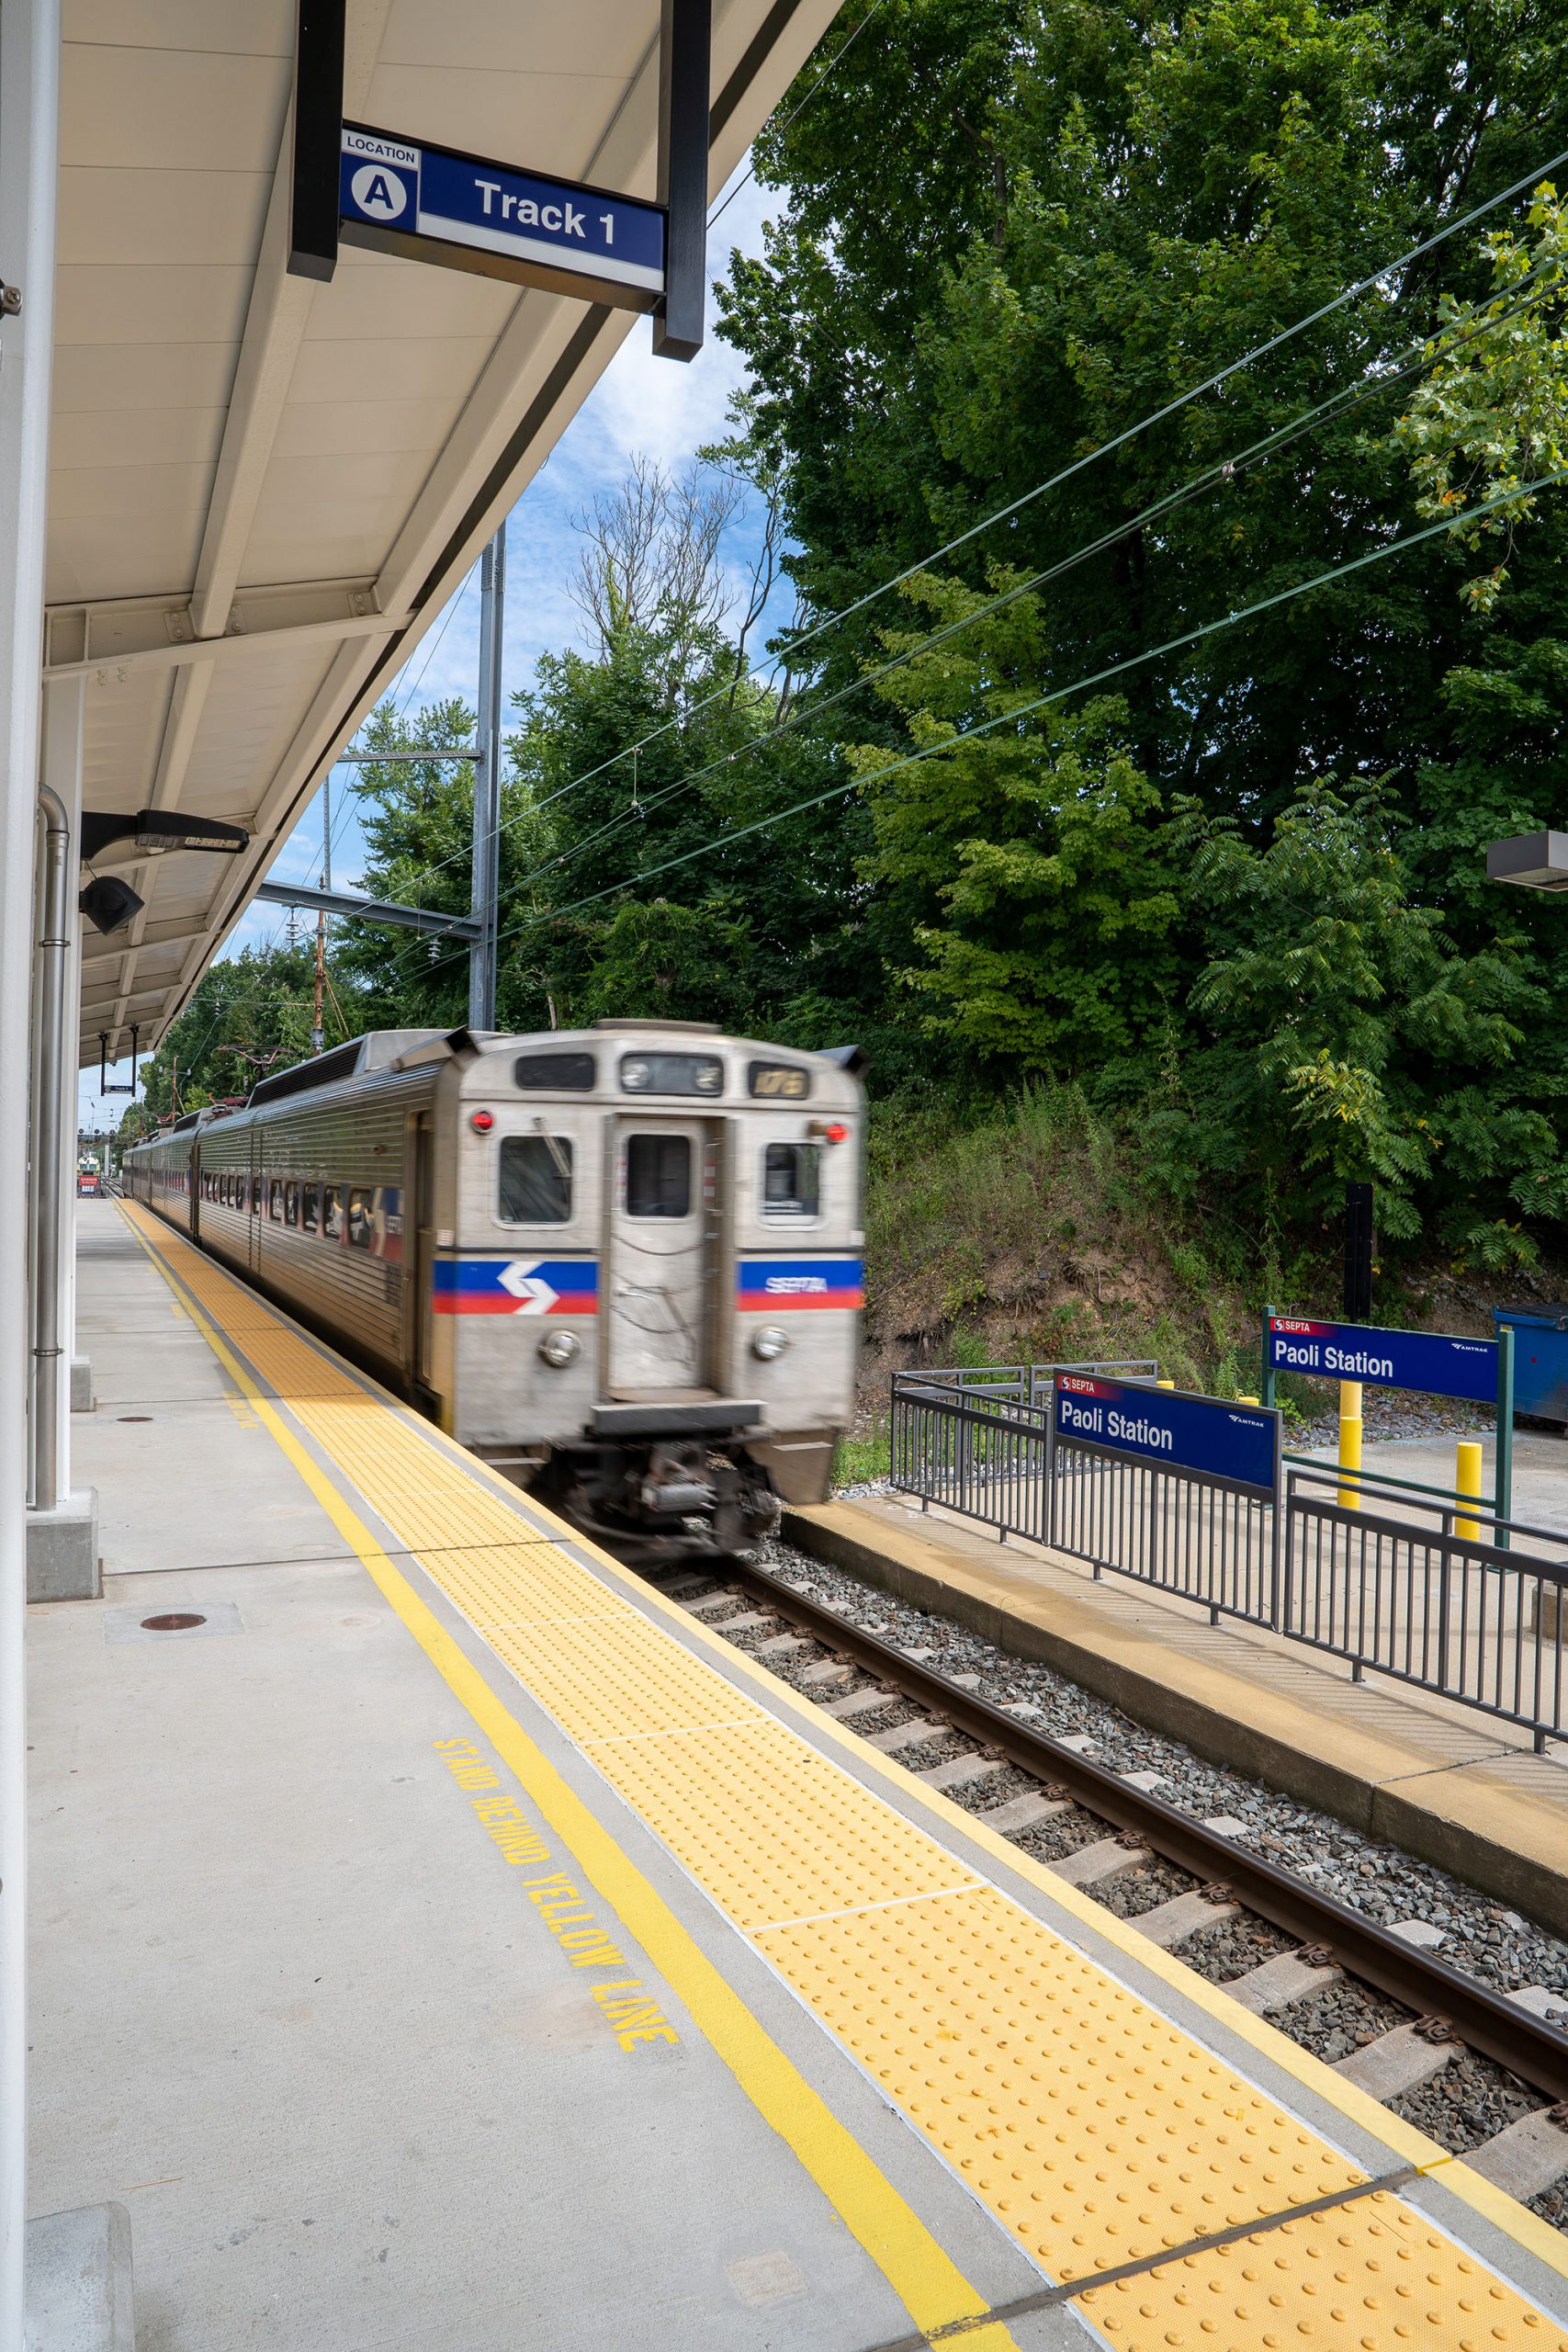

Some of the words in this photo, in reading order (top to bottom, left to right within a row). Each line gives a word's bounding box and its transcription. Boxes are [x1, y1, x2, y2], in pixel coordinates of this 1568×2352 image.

[346, 136, 416, 164] LOCATION
[363, 174, 395, 210] A
[474, 178, 587, 239] Track
[599, 213, 615, 245] 1
[764, 1276, 829, 1294] SEPTA
[1285, 1321, 1311, 1333] SEPTA
[1275, 1340, 1320, 1367] Paoli
[1324, 1346, 1393, 1378] Station
[1460, 1345, 1488, 1353] AMTRAK
[1071, 1378, 1095, 1394] SEPTA
[1061, 1399, 1103, 1434] Paoli
[1107, 1410, 1173, 1451] Station
[1236, 1418, 1265, 1428] AMTRAK
[433, 1736, 502, 1791] STAND
[469, 1794, 552, 1866] BEHIND
[522, 1871, 628, 1968] YELLOW
[589, 1978, 682, 2053] LINE
